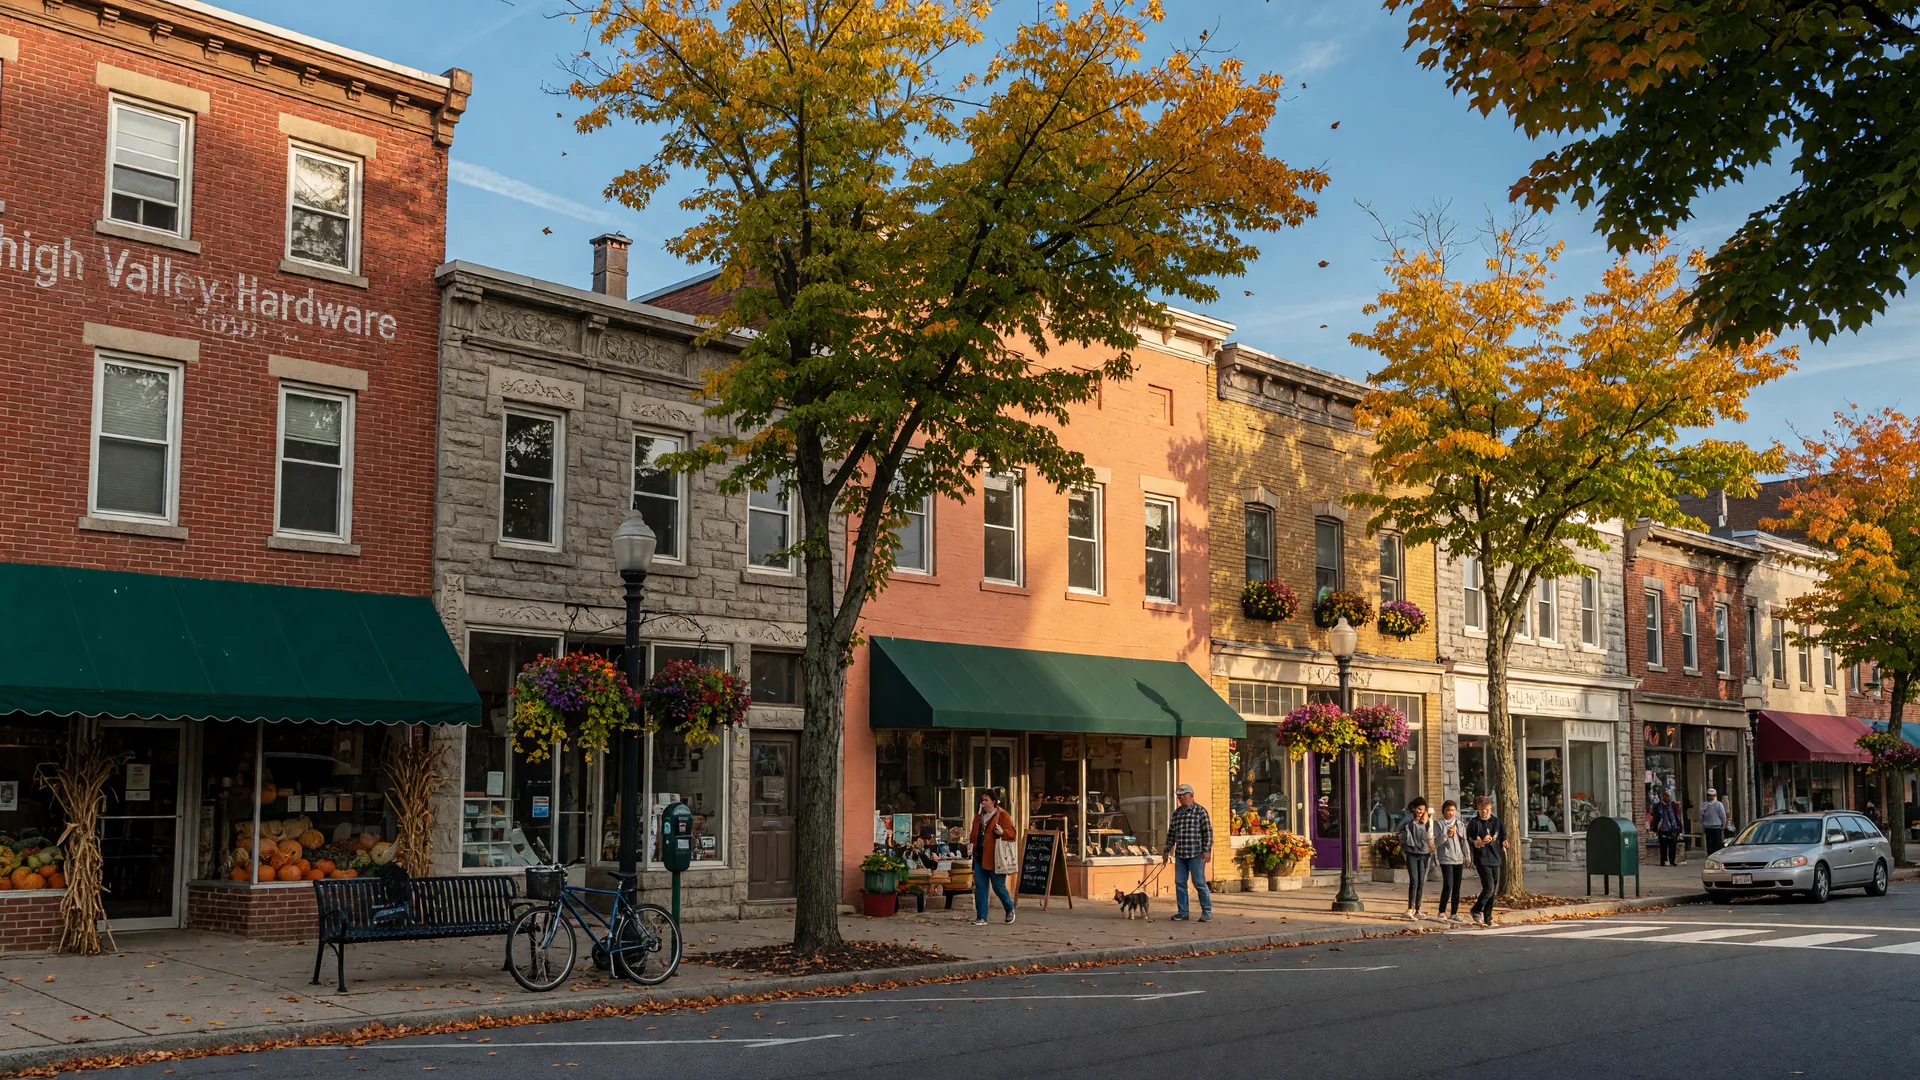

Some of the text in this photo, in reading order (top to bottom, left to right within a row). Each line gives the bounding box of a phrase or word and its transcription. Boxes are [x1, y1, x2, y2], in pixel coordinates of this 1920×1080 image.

[0, 224, 398, 341] high Valley Hardware
